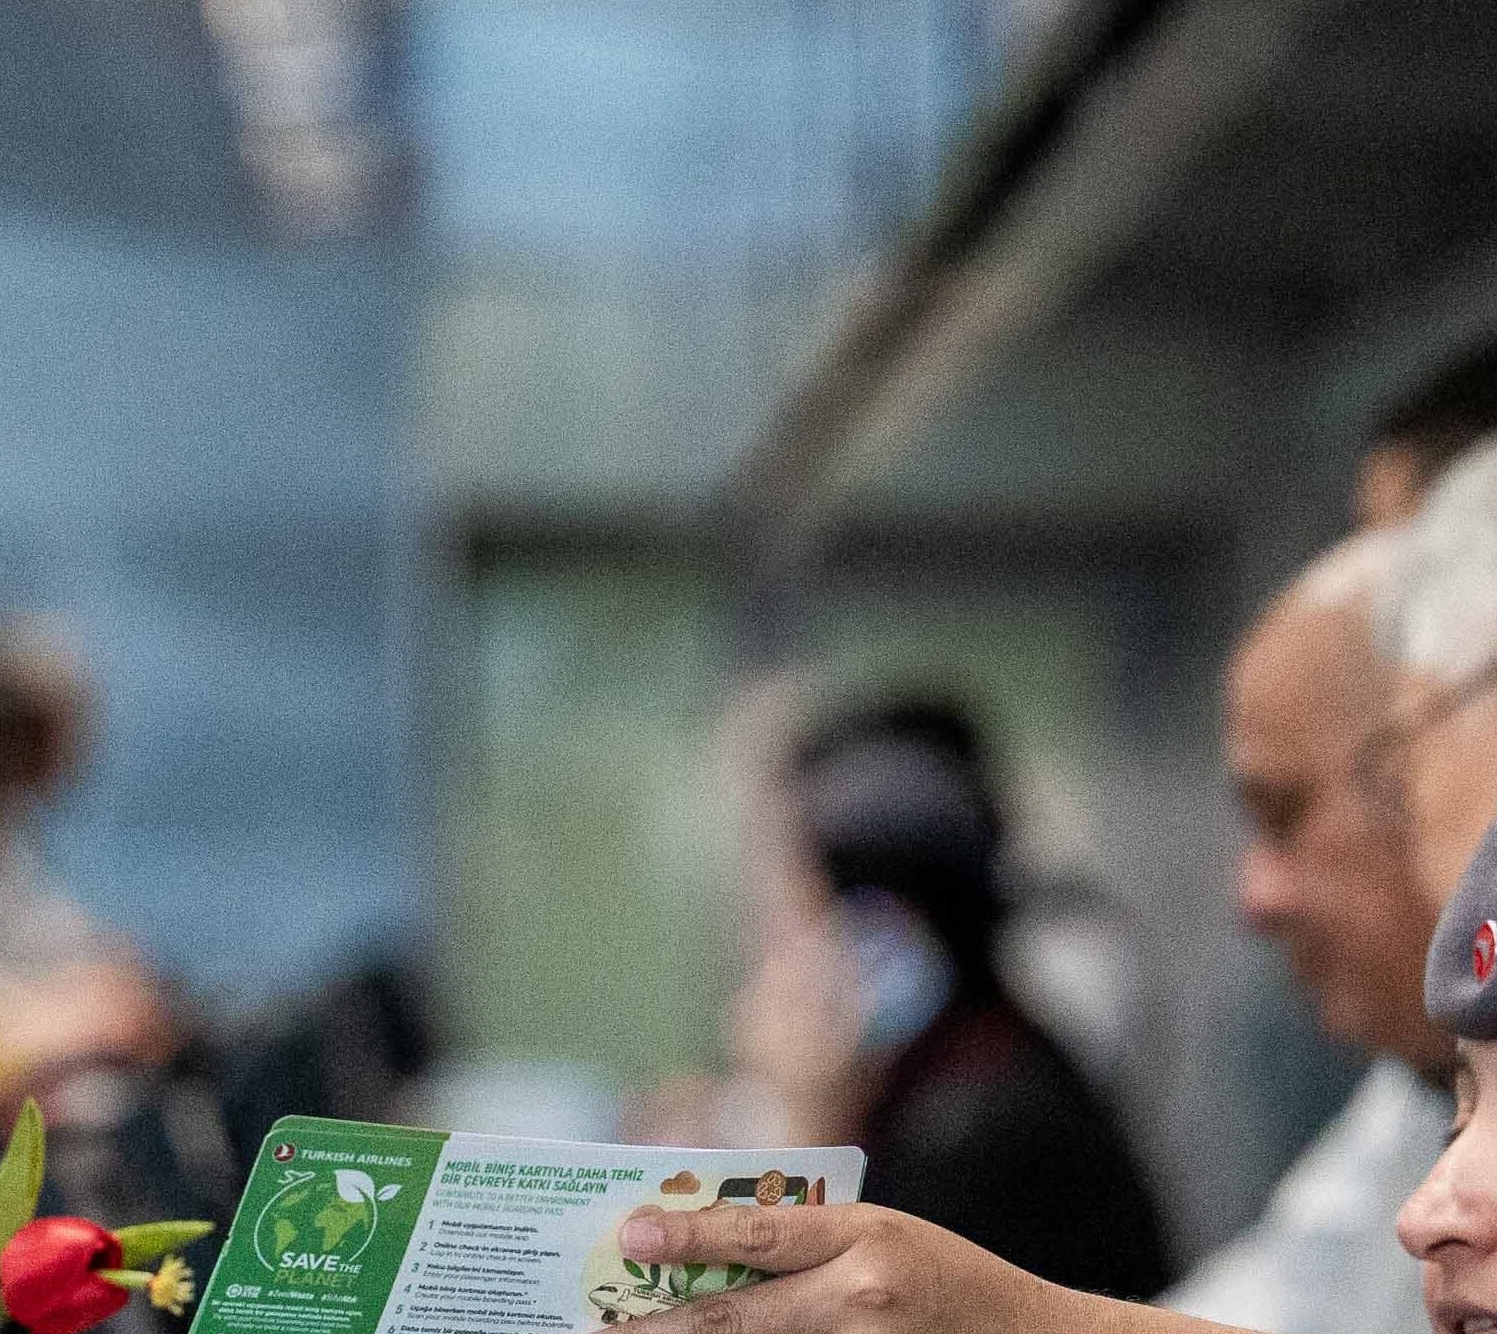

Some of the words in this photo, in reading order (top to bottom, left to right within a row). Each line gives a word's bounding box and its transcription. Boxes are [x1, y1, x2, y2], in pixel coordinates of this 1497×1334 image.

[302, 1150, 354, 1162] TURKISH
[357, 1154, 412, 1166] AIRLINES
[445, 1161, 481, 1173] MOBİL
[485, 1162, 515, 1177] BİNİŞ
[518, 1165, 573, 1177] KARTIYLA
[576, 1168, 606, 1179] DAHA
[610, 1167, 645, 1180] TEMİZ
[441, 1174, 461, 1184] BİR
[464, 1175, 515, 1189] ÇEVREYE
[517, 1179, 550, 1190] KATKI
[554, 1179, 608, 1193] SAĞLAYIN
[429, 1220, 435, 1229] 1
[419, 1242, 428, 1251] 2
[280, 1252, 340, 1271] SAVE
[339, 1264, 363, 1274] THE
[411, 1263, 419, 1272] 3
[274, 1268, 359, 1288] PLANET
[404, 1284, 411, 1292] 4
[396, 1304, 403, 1314] 5
[388, 1326, 395, 1334] 6
